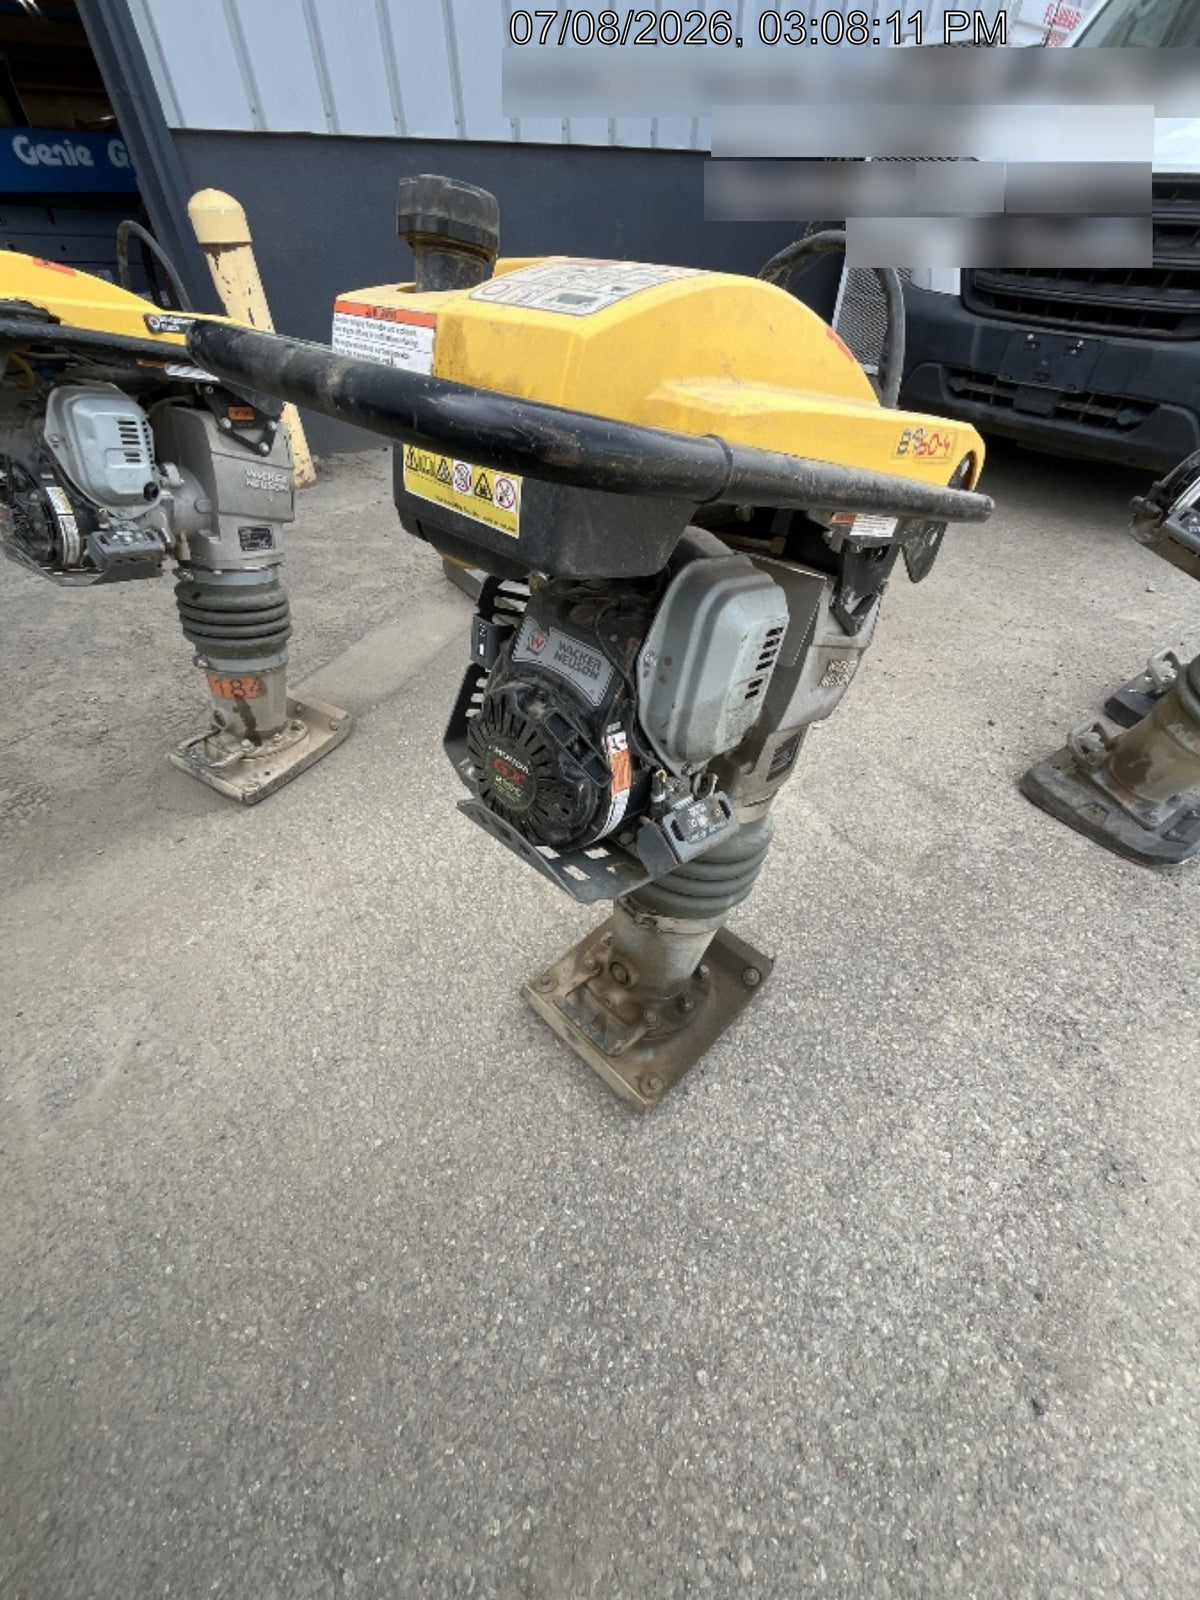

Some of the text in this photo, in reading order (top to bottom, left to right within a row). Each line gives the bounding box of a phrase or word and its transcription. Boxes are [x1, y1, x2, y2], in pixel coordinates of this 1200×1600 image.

[12, 134, 95, 166] Genie
[554, 650, 601, 681] NEUSON
[559, 641, 603, 672] WACKER
[492, 757, 526, 789] GX
